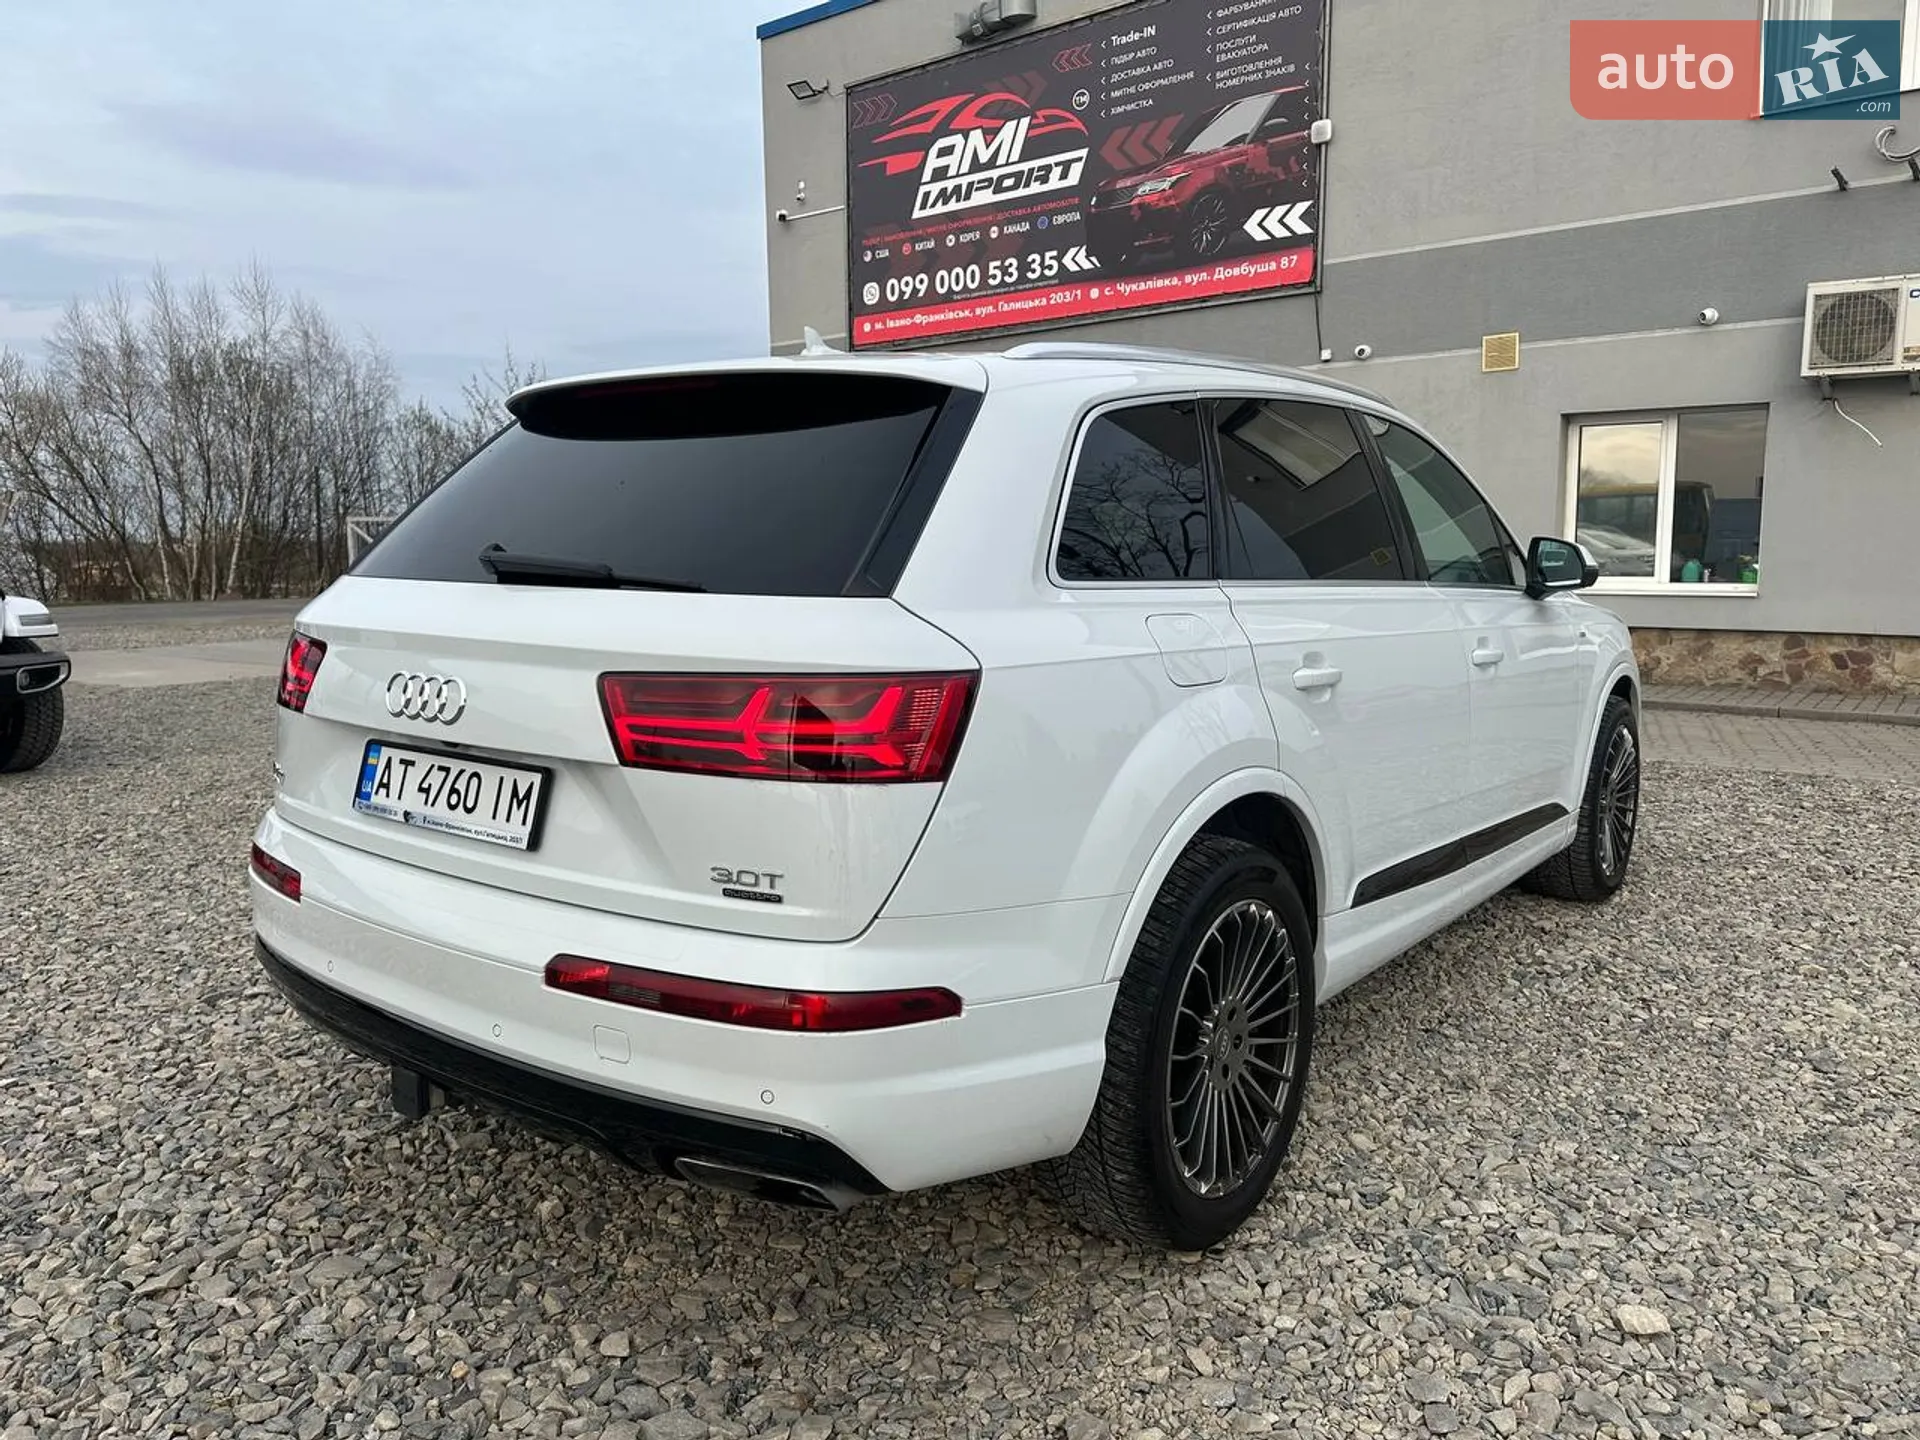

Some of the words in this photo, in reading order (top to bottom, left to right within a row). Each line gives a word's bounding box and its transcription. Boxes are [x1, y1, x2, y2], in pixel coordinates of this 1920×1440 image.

[1216, 0, 1276, 18] ФАРБУВАНН
[1216, 12, 1276, 35] СЕРТИФІКАЦІЯ
[1278, 5, 1302, 19] АВТО
[1111, 25, 1156, 46] Trade-IN
[1216, 34, 1257, 52] ПОСЛУГИ
[1136, 46, 1158, 58] АВТО
[1216, 43, 1269, 63] ЕВАКУАТОРА
[1110, 64, 1151, 83] ДОСТАВКА
[1152, 58, 1174, 71] АВТО
[1215, 56, 1283, 80] ВИГОТОВЛЕННЯ
[1215, 72, 1263, 90] НОМЕРНИХ
[1110, 85, 1136, 98] МИТНЕ
[920, 116, 1031, 183] AMI
[918, 156, 1083, 212] IMPORT
[1003, 221, 1030, 234] КАНАДА
[1052, 211, 1081, 225] ЄВРОПА
[885, 273, 929, 302] 099
[935, 264, 981, 295] 000
[988, 257, 1018, 286] 53
[1026, 250, 1059, 280] 35
[1104, 287, 1114, 296] с.
[1184, 272, 1210, 287] вул.
[1213, 262, 1277, 282] Довбуша
[1280, 255, 1298, 270] 87
[975, 303, 996, 318] вул.
[998, 295, 1047, 314] Галицька
[1049, 289, 1082, 306] 203/1
[361, 780, 372, 794] UA
[374, 756, 416, 801] AT
[417, 762, 482, 815] 4760
[491, 775, 534, 827] IM
[723, 889, 781, 902] quattro
